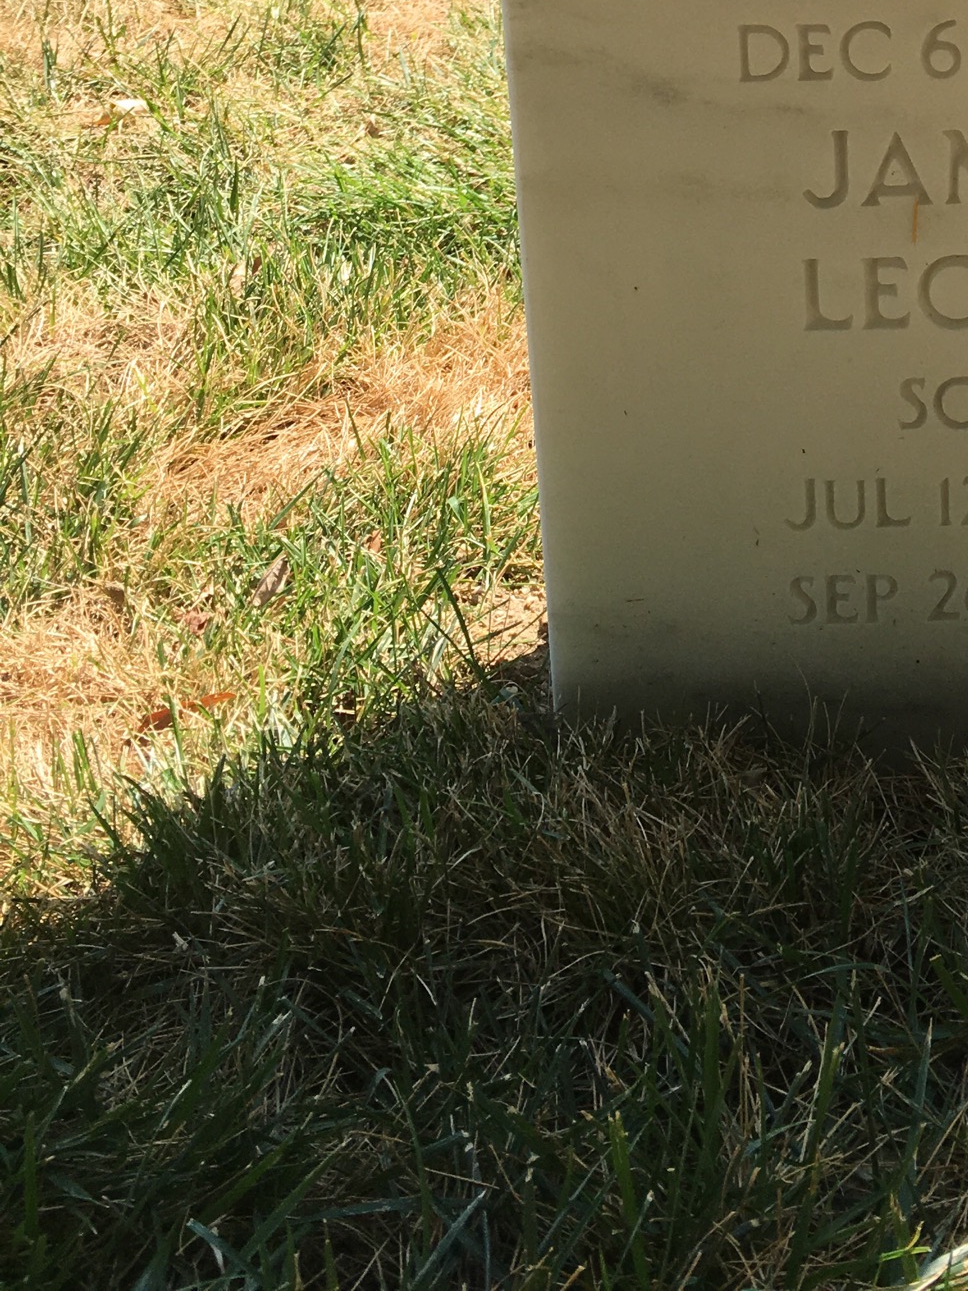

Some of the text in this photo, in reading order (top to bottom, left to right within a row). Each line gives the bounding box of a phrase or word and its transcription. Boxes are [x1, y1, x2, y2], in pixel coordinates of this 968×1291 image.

[737, 19, 893, 84] DEC
[920, 18, 963, 80] 6
[784, 476, 913, 532] JUL
[787, 573, 900, 627] SEP
